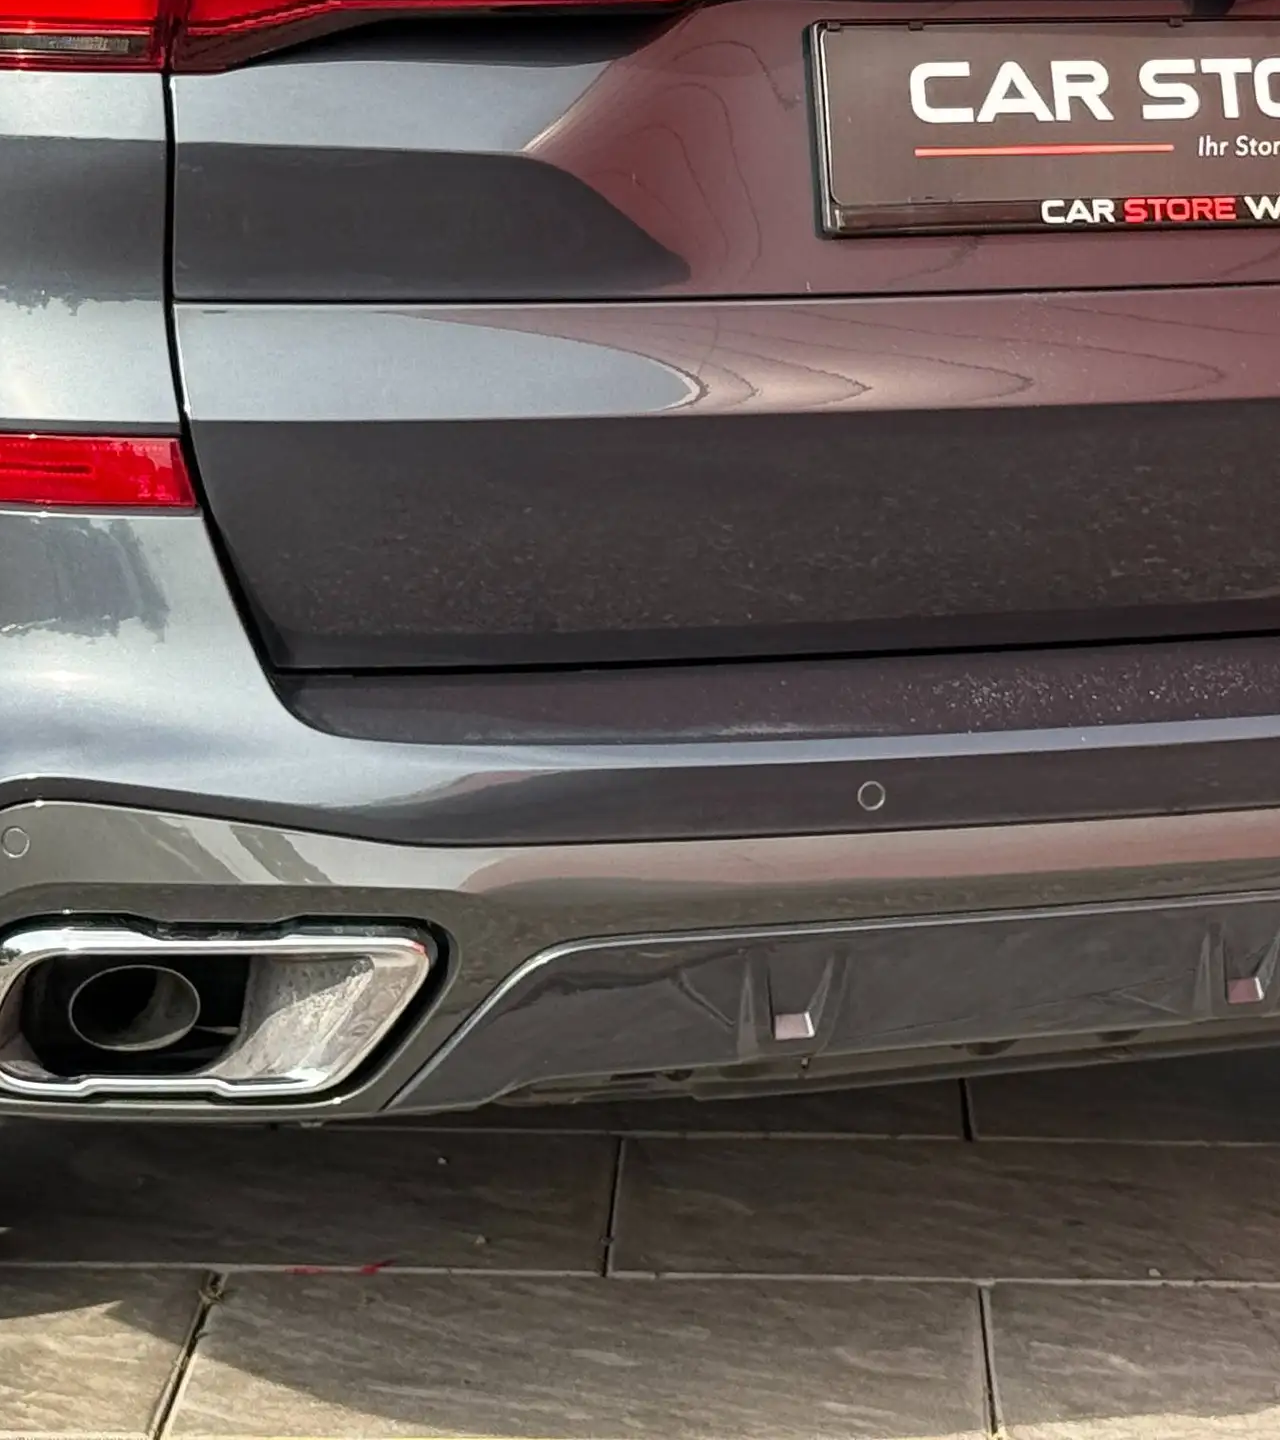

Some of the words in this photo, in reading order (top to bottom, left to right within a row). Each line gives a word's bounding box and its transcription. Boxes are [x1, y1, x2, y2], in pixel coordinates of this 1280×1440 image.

[909, 60, 1115, 123] CAR
[1198, 134, 1230, 157] Ihr
[1041, 198, 1116, 224] CAR
[1123, 196, 1237, 222] STORE
